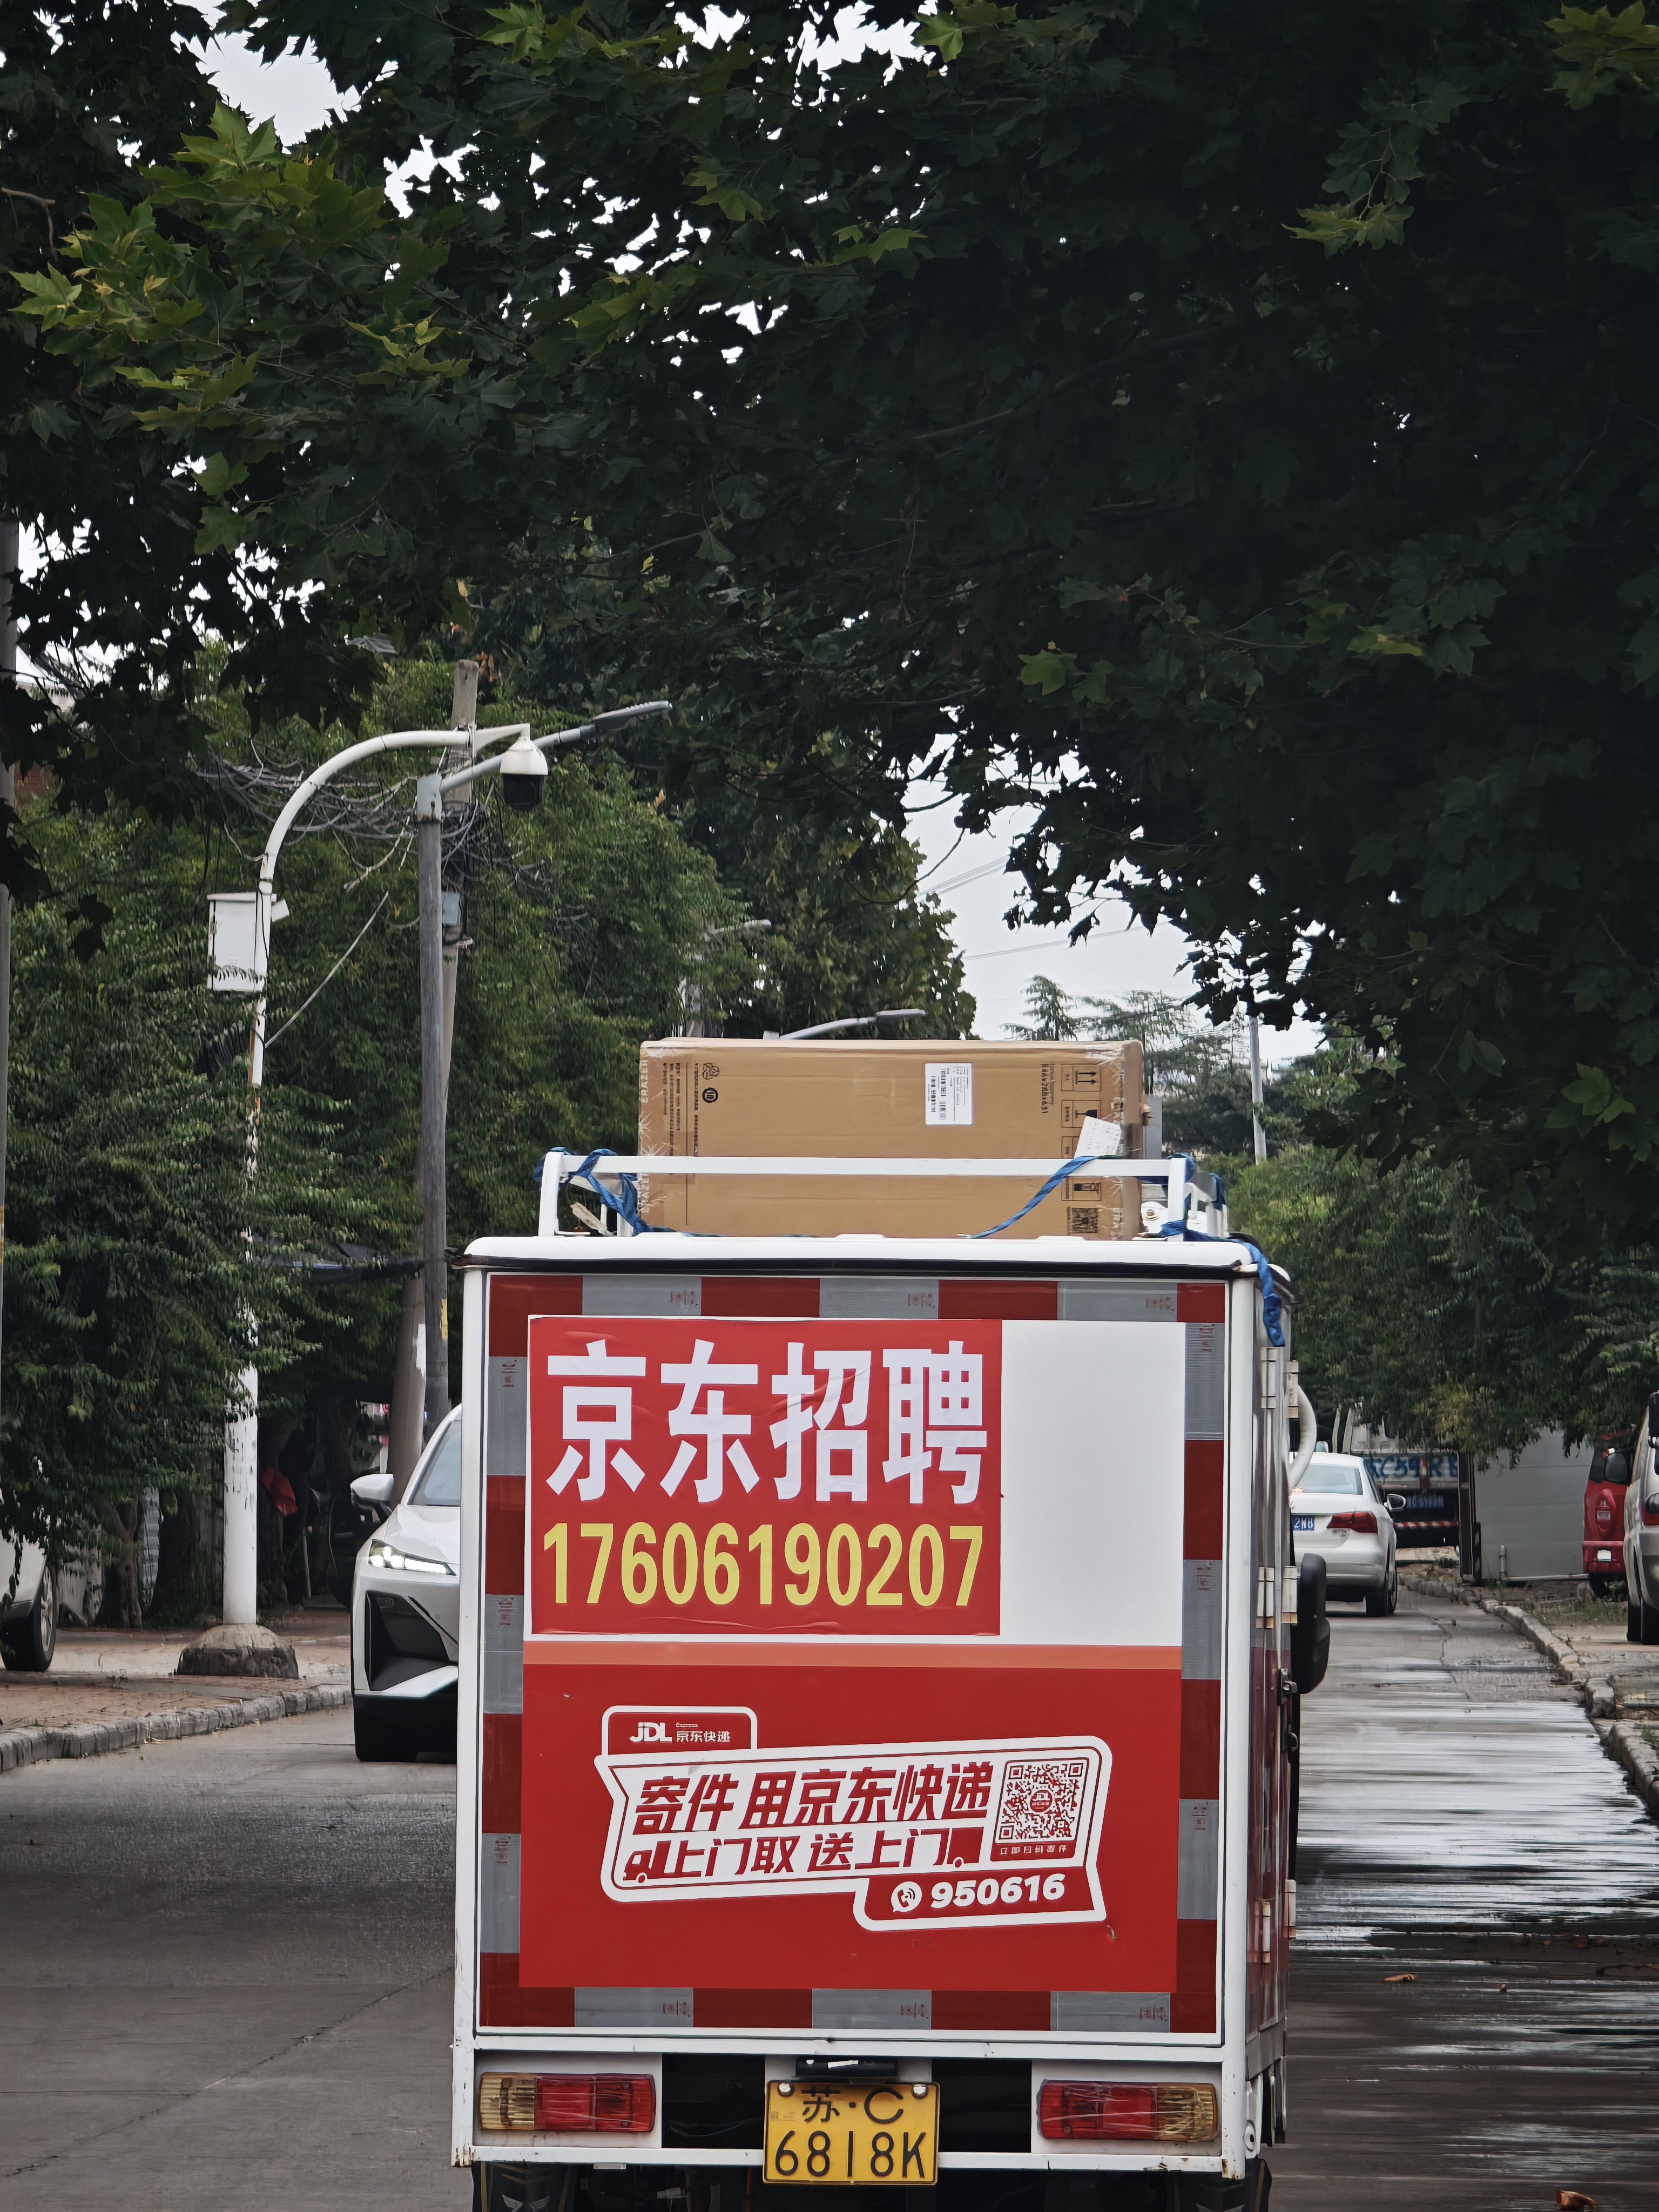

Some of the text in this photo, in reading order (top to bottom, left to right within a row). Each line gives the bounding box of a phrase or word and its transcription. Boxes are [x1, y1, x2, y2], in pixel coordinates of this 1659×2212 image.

[546, 1339, 987, 1503] 京东招聘
[544, 1521, 983, 1607] 17606190207
[629, 1722, 672, 1742] JDL
[632, 1761, 994, 1835] 寄件用京东快递
[930, 1873, 1065, 1908] 950616
[775, 2130, 926, 2178] 6818K
